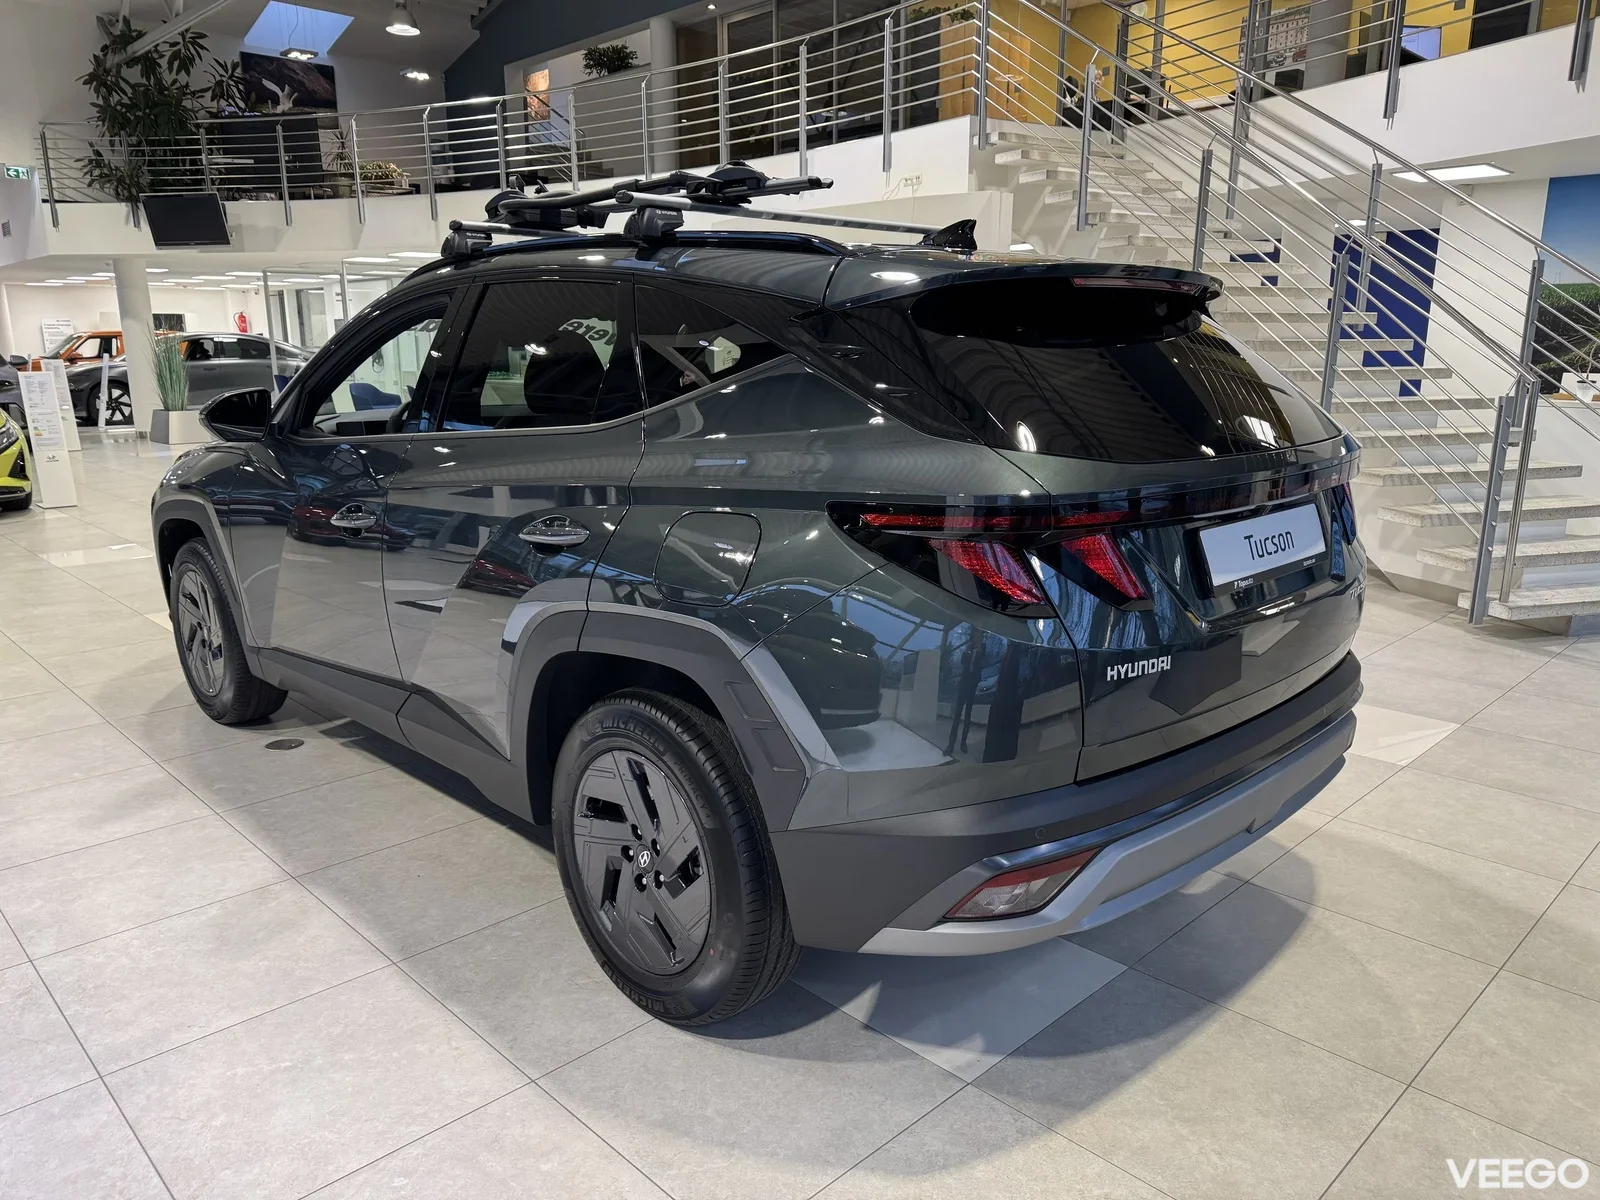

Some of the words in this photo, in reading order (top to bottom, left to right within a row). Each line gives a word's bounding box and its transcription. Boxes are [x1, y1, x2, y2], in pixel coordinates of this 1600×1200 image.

[1243, 530, 1295, 561] Tucson
[1238, 578, 1254, 588] Topauto
[1106, 655, 1172, 682] HYUNDAI
